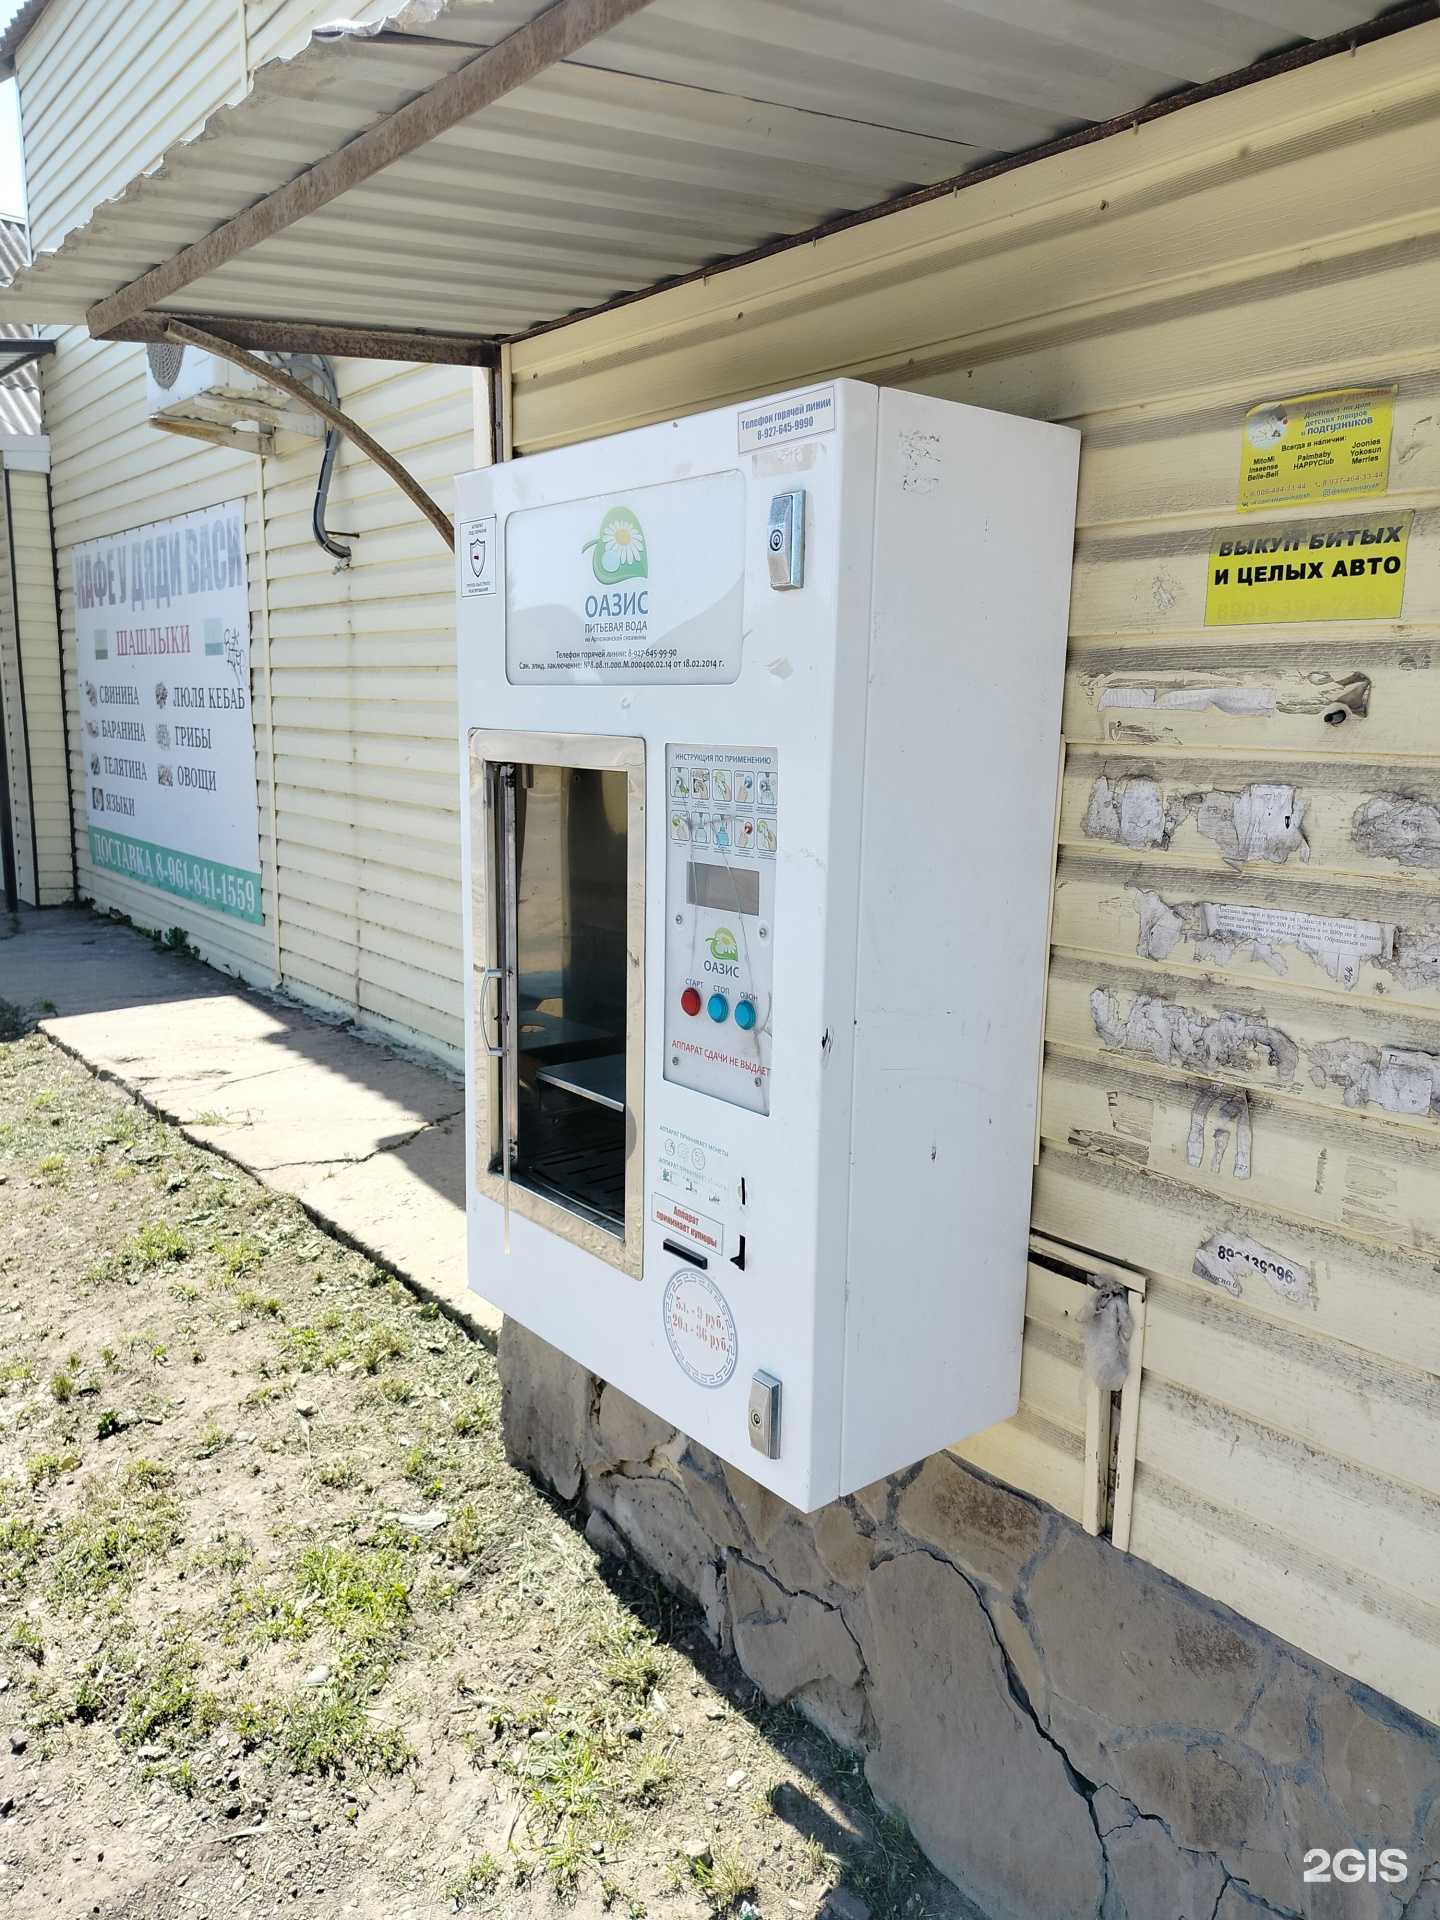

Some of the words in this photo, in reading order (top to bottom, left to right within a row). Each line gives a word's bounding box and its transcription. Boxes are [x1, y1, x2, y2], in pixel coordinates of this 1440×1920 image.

[741, 414, 773, 431] Телефон
[774, 404, 805, 421] горячей
[806, 398, 832, 413] линии
[757, 416, 814, 441] 8-927-645-9990
[1307, 417, 1373, 435] подгузников
[1350, 446, 1382, 457] Yokosun
[1352, 438, 1381, 449] Joonies
[1293, 457, 1335, 470] HAPPYClub
[1297, 450, 1332, 462] Palmbaby
[1351, 455, 1379, 465] Merries
[1218, 535, 1300, 557] ВЫКУП
[1308, 526, 1404, 550] БИТЫХ
[117, 546, 127, 604] У
[131, 532, 183, 612] ДЯДИ
[185, 516, 243, 594] ВАСИ
[1215, 569, 1229, 586] И
[1237, 562, 1324, 587] ЦЕЛЫХ
[1331, 556, 1401, 578] АВТО
[585, 591, 649, 618] ОАЗИС
[584, 621, 625, 634] ПИТЬЕВАЯ
[626, 620, 648, 633] ВОДА
[116, 624, 192, 657] ШАШЛЫКИ
[556, 650, 580, 659] Телефон
[581, 649, 605, 660] горячей
[683, 658, 717, 669] 18.02.2014
[718, 660, 725, 668] г.
[100, 684, 140, 705] СВИНИНА
[173, 687, 206, 709] ЛЮЛЯ
[208, 687, 246, 710] КЕБАБ
[101, 719, 146, 742] БАРАНИНА
[175, 726, 212, 749] ГРИБЫ
[104, 756, 148, 782] ТЕЛЯТИНА
[675, 752, 714, 764] ИНСТРУКЦИЯ
[714, 755, 724, 763] ПО
[725, 755, 772, 765] ПРИМЕНЕНИЮ
[177, 766, 217, 792] ОВОЩИ
[106, 795, 136, 817] ЯЗЫКИ
[94, 833, 154, 880] ДОСТАВКА
[156, 852, 256, 914] 8-961-841-1559
[704, 960, 740, 978] ОАЗИС
[685, 977, 704, 989] СТАРТ
[713, 984, 730, 995] СТОП
[671, 1039, 703, 1056] АППАРАТ
[704, 1048, 728, 1065] СДАЧИ
[729, 1056, 739, 1067] НЕ
[740, 1060, 770, 1077] ВЫДАЕТ
[673, 1205, 699, 1226] Аппарат
[656, 1210, 690, 1235] принимает
[690, 1228, 717, 1249] купюры
